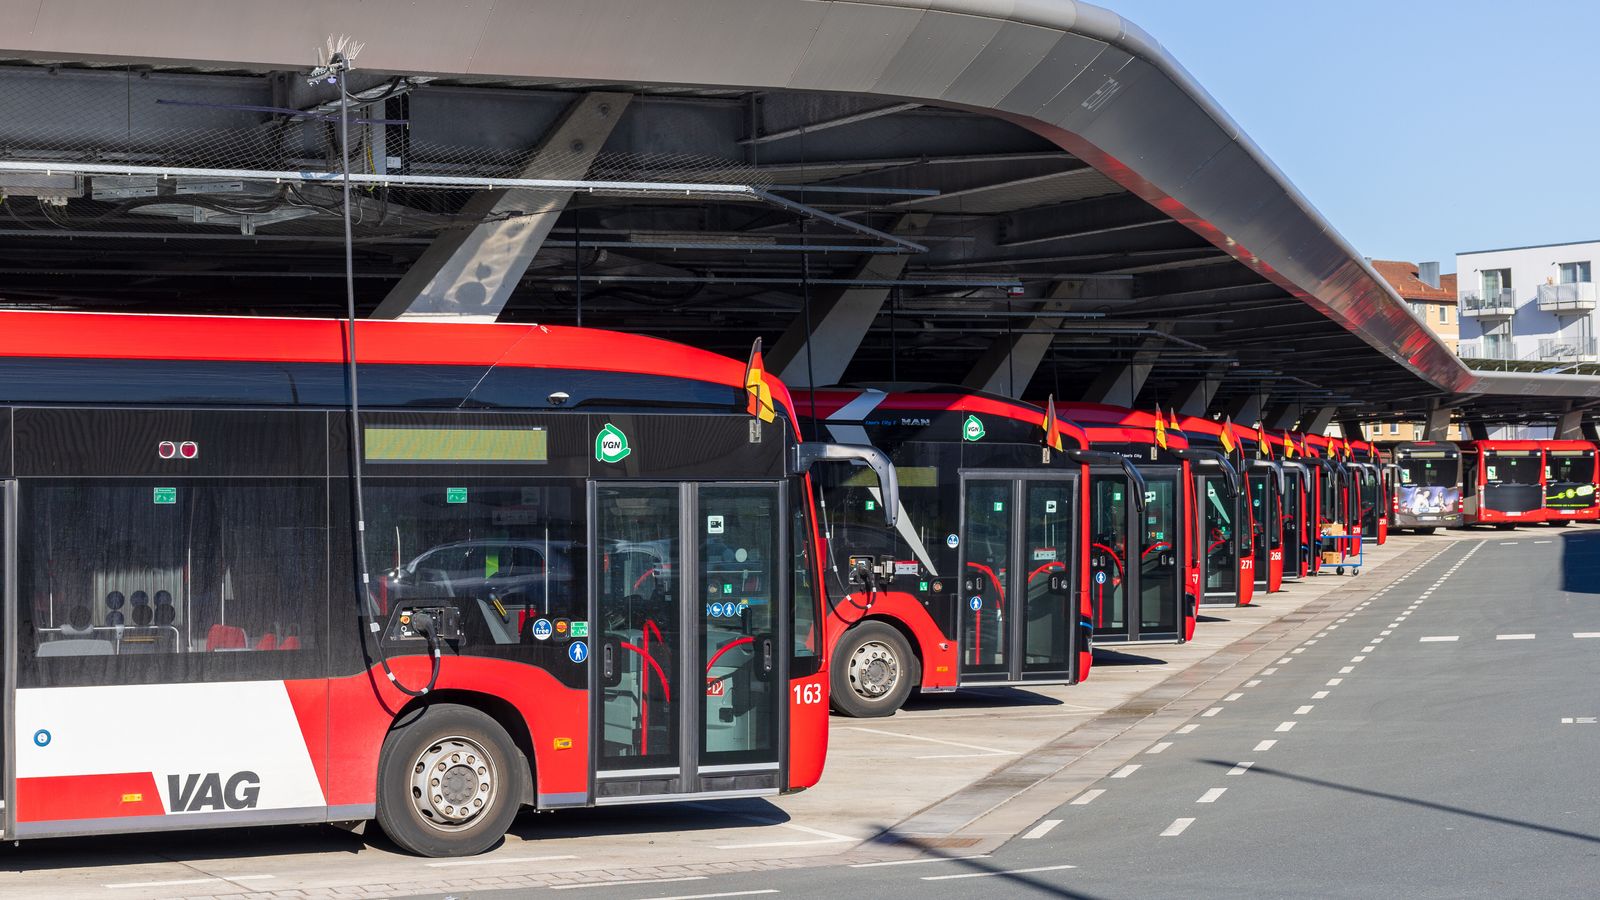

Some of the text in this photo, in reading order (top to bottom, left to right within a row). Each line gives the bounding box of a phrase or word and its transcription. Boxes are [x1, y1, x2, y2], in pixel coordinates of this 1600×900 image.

[901, 418, 930, 426] MAN
[602, 441, 621, 449] VGN
[1270, 551, 1281, 561] 268
[1241, 559, 1252, 569] 271
[794, 683, 821, 704] 163
[167, 771, 260, 812] VAG
